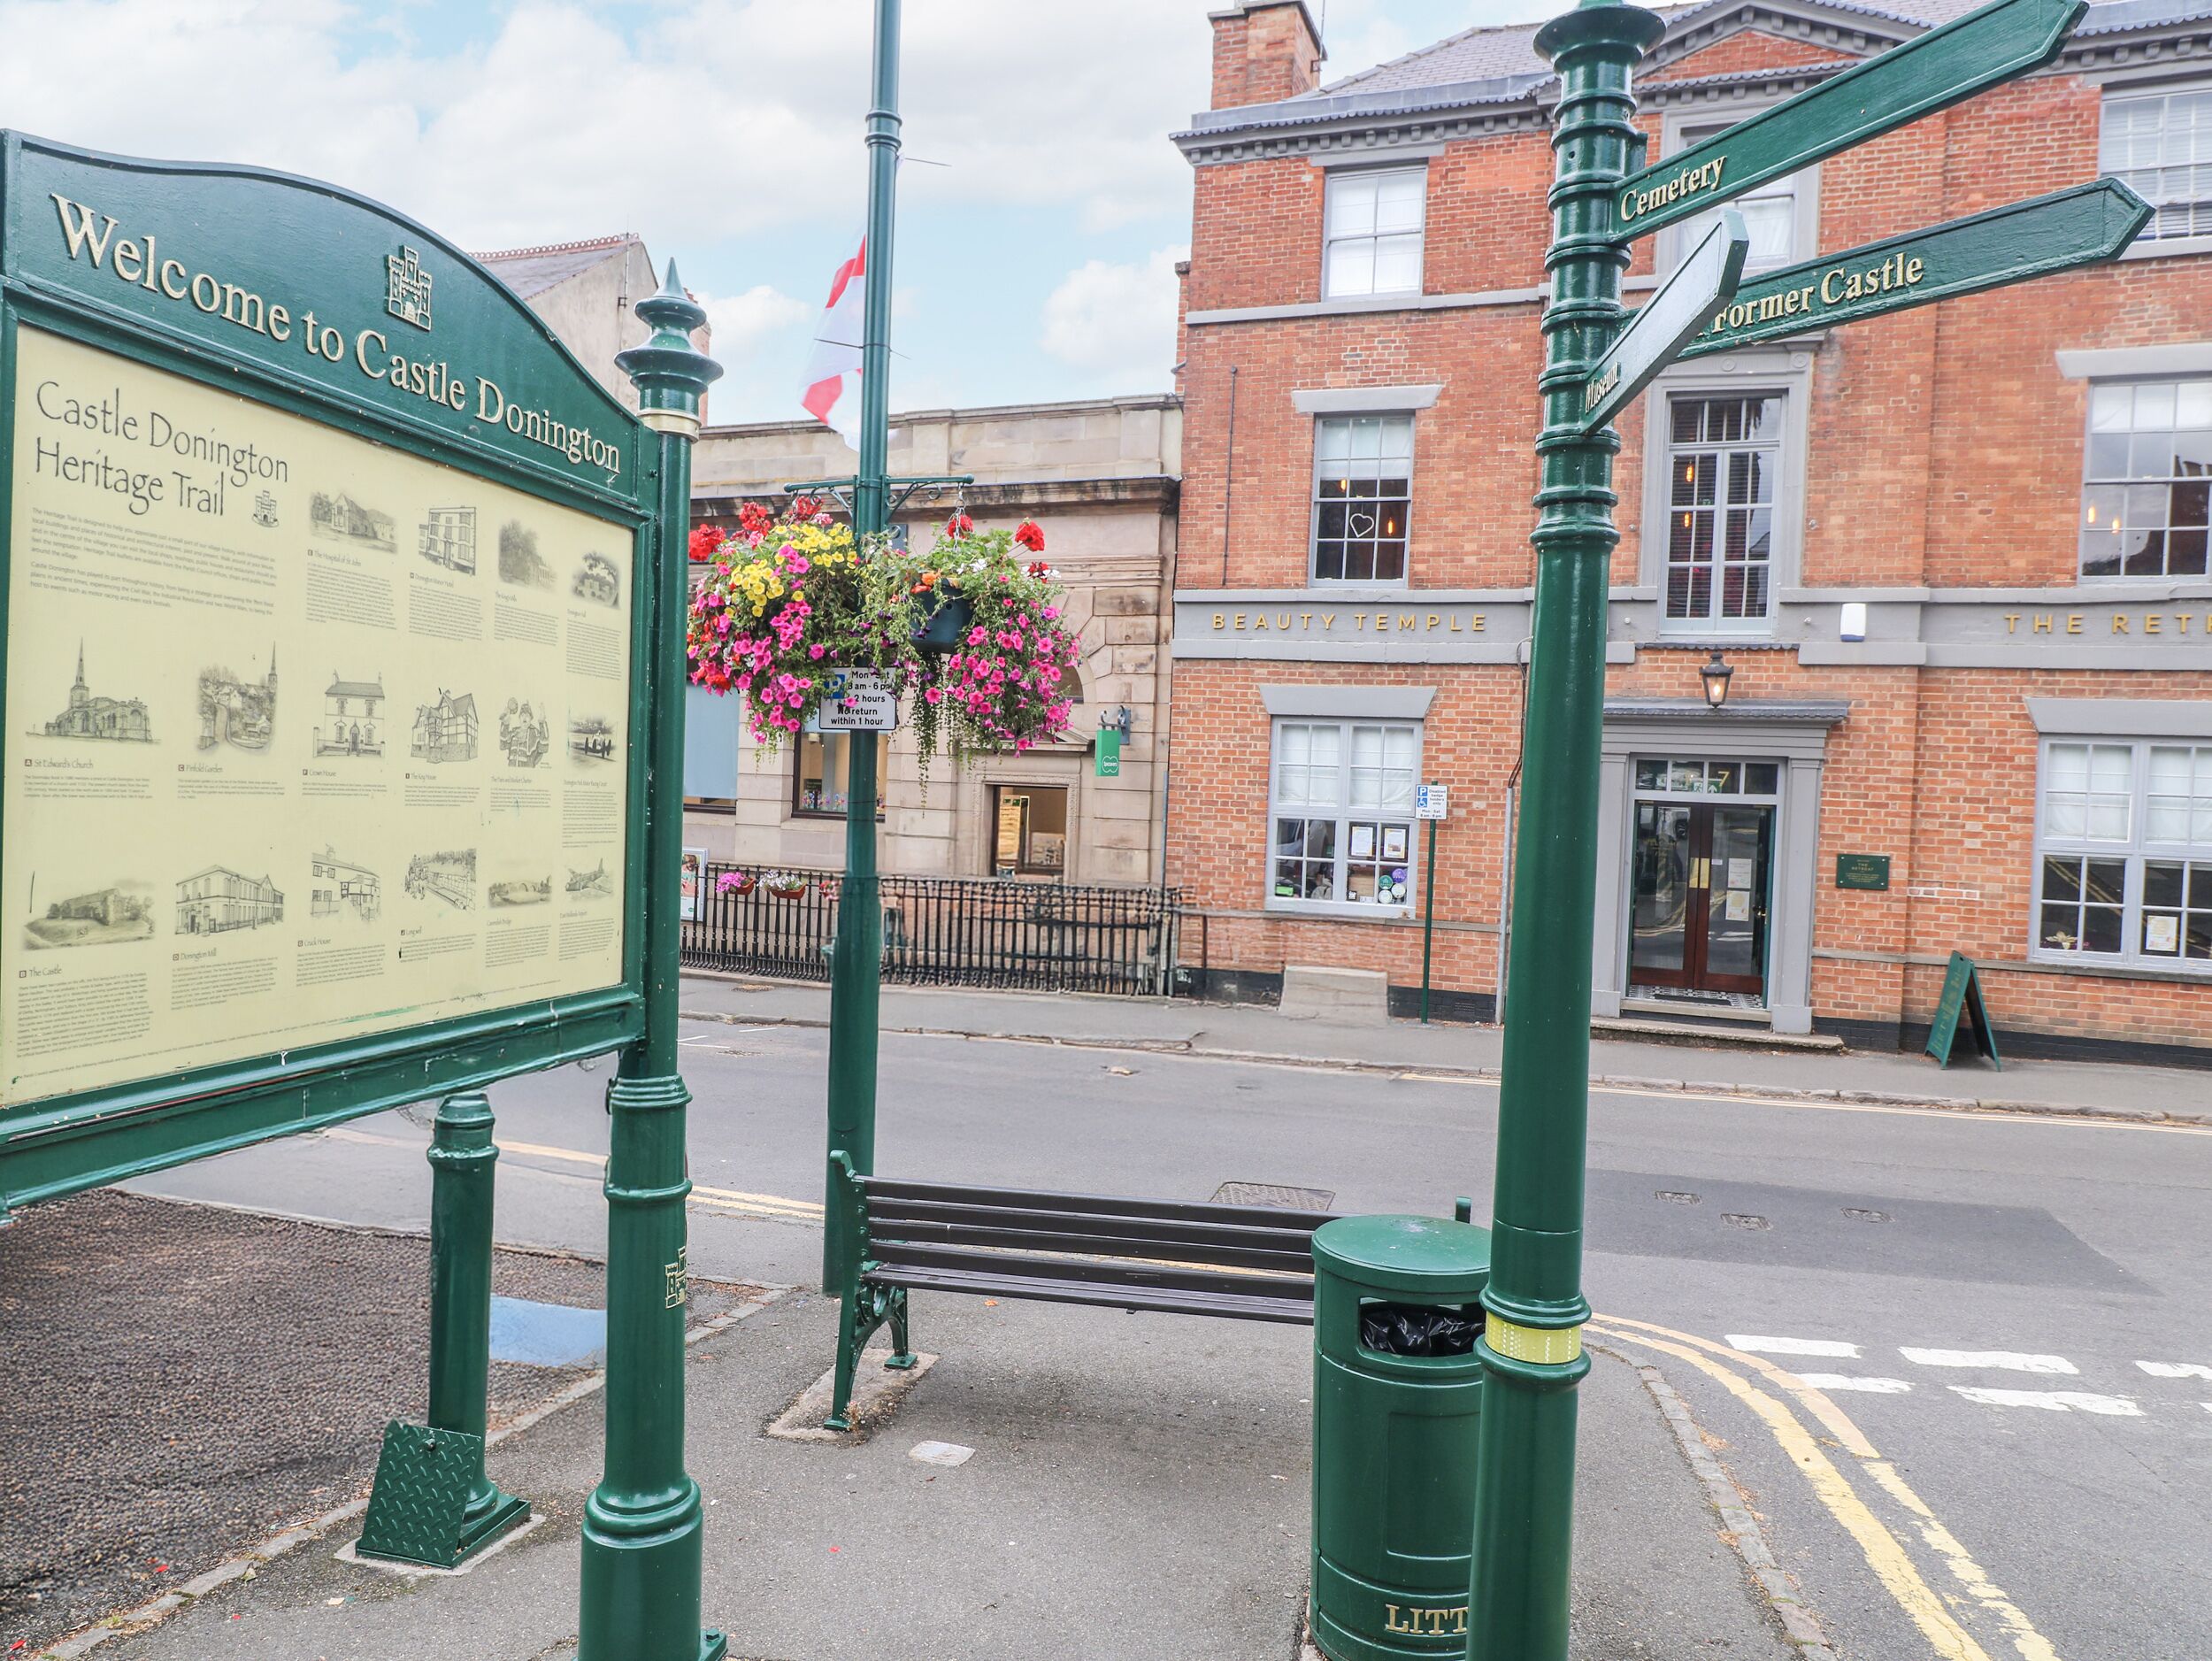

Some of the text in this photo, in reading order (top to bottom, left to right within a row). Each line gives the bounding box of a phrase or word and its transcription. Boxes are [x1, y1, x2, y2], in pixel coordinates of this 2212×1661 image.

[1620, 155, 1727, 222] Cemetery
[1820, 252, 1924, 304] Castle
[50, 192, 620, 473] Welcome to Castle Donington
[1585, 361, 1620, 413] Museum
[35, 381, 288, 489] Castle Donington
[35, 436, 225, 517] Heritage Trail
[1212, 613, 1486, 632] BEAUTY TEMPLE
[2004, 614, 2085, 634] THE
[72, 758, 94, 769] Church
[29, 966, 42, 977] The
[42, 964, 63, 976] Castle
[180, 951, 207, 962] Donington
